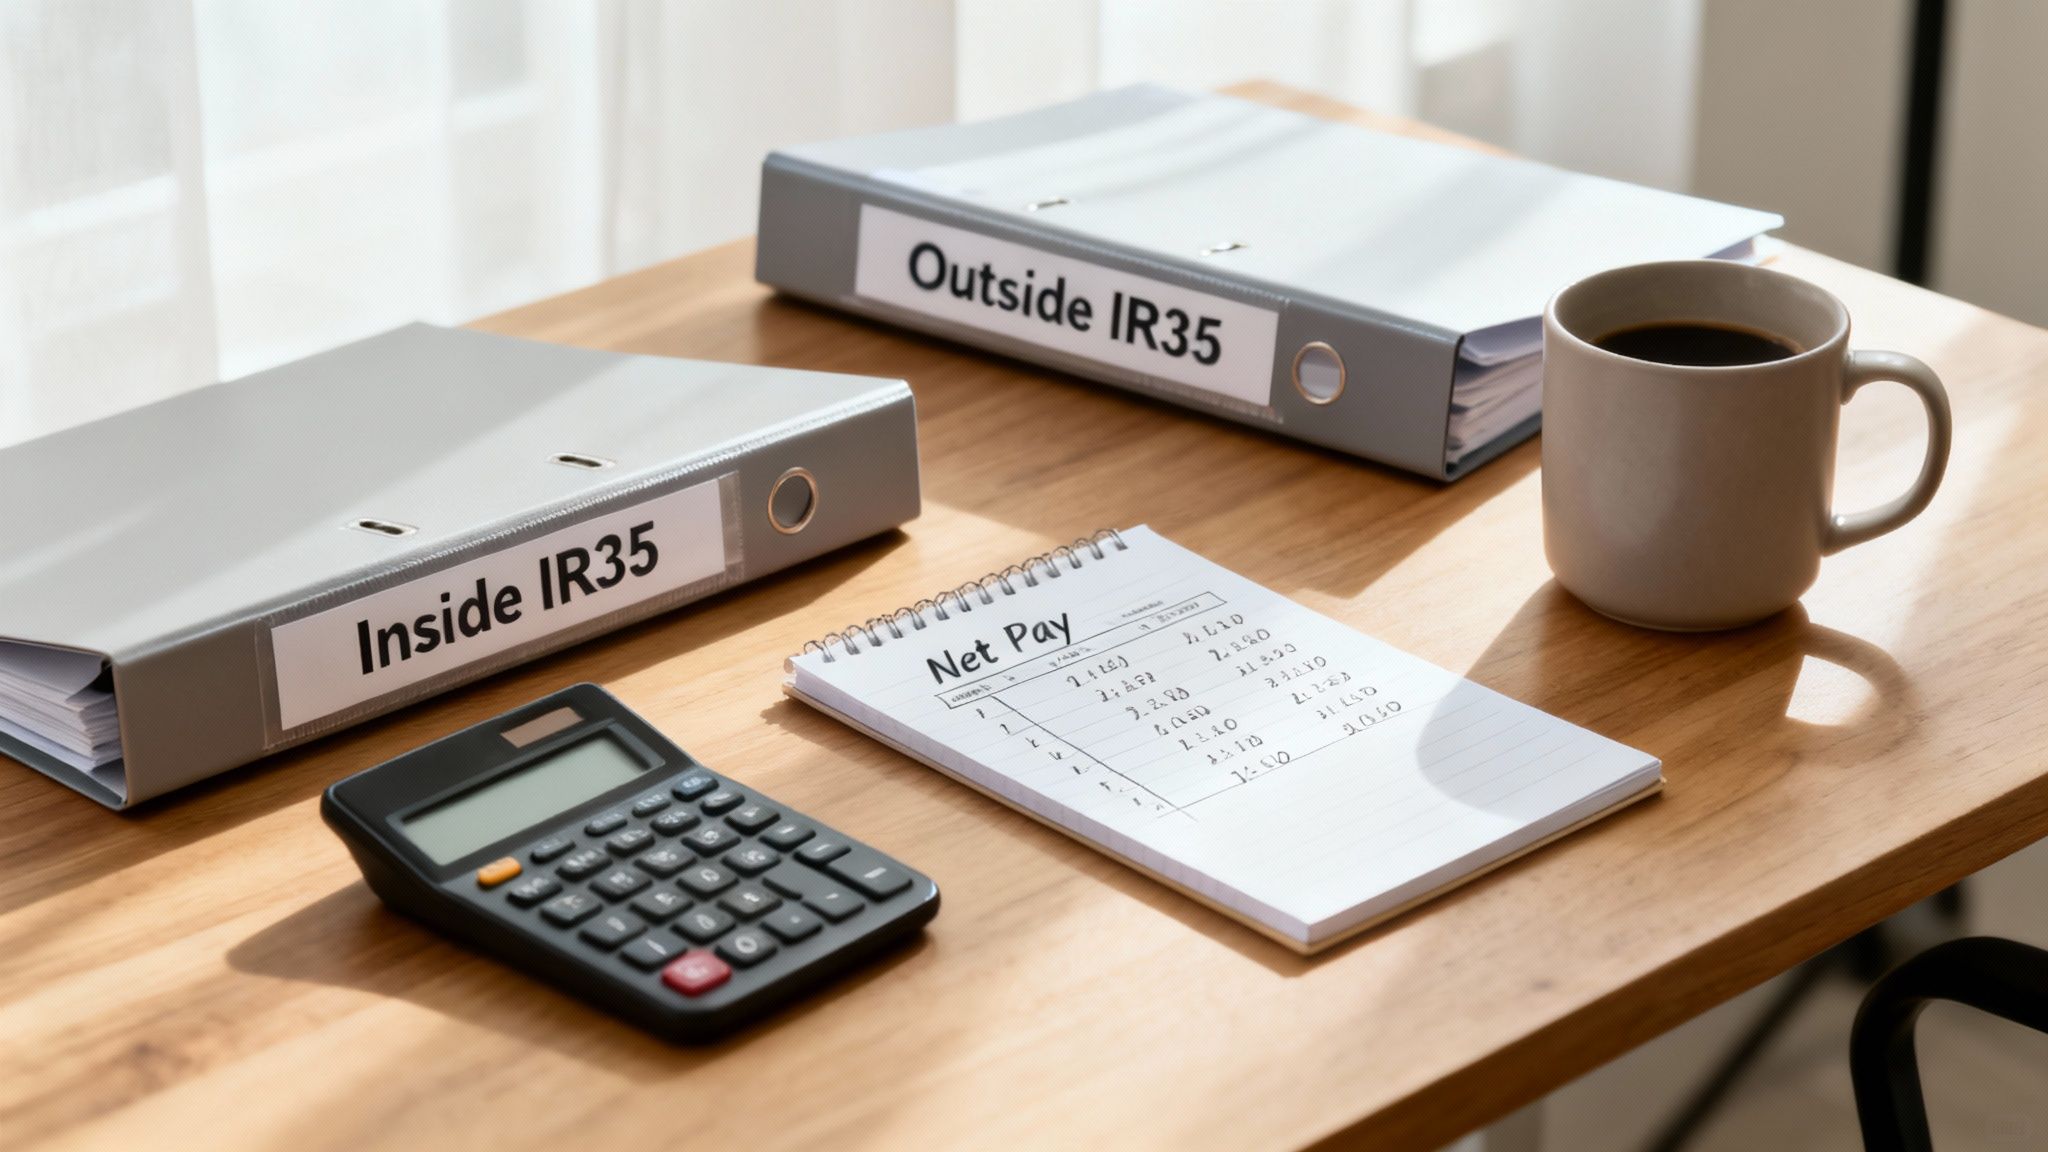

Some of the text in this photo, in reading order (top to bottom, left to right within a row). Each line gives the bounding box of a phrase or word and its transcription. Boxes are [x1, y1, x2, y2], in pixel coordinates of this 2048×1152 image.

[908, 242, 1223, 366] Outside IR35
[357, 520, 659, 675] Inside IR35
[926, 638, 999, 685] Net
[1003, 612, 1071, 653] Pay
